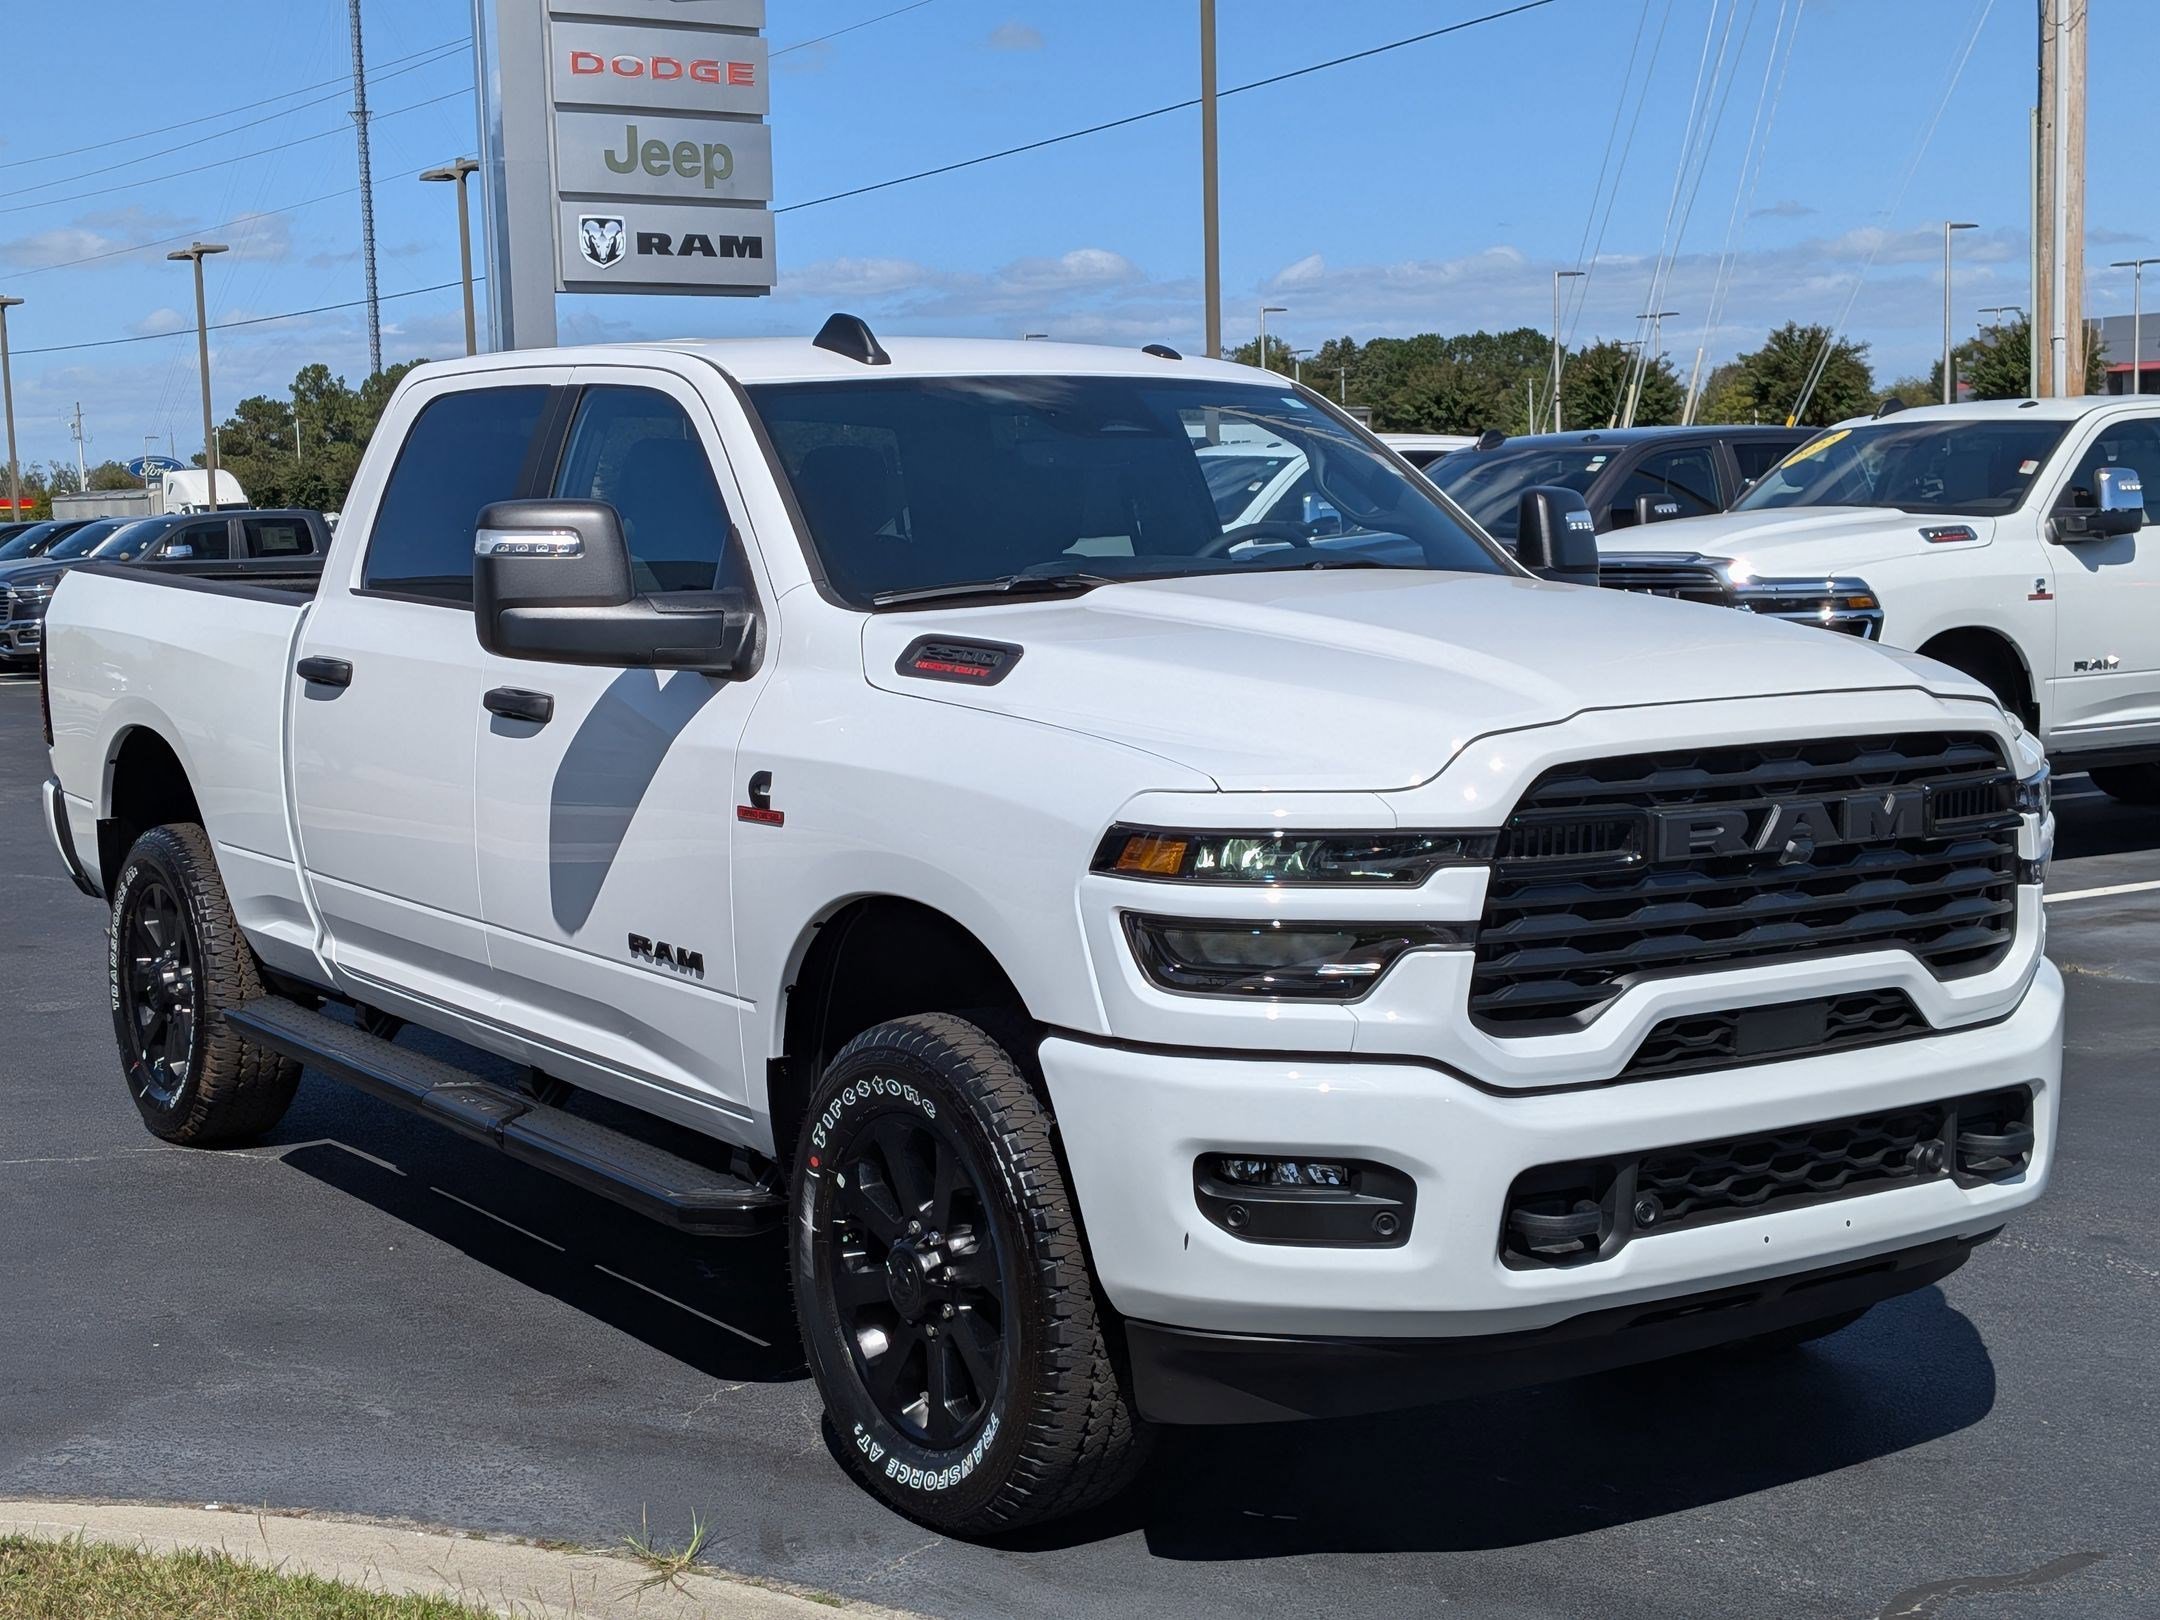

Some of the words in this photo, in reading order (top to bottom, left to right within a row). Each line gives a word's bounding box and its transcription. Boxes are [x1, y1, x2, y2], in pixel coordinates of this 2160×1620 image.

[570, 51, 755, 86] DODGE
[604, 124, 733, 189] Jeep
[636, 232, 763, 259] RAM
[2073, 655, 2120, 672] RAM
[1657, 788, 1922, 861] RAM
[628, 932, 704, 974] RAM
[812, 1075, 937, 1149] Firestone
[885, 1412, 1000, 1491] TRANSFORCE
